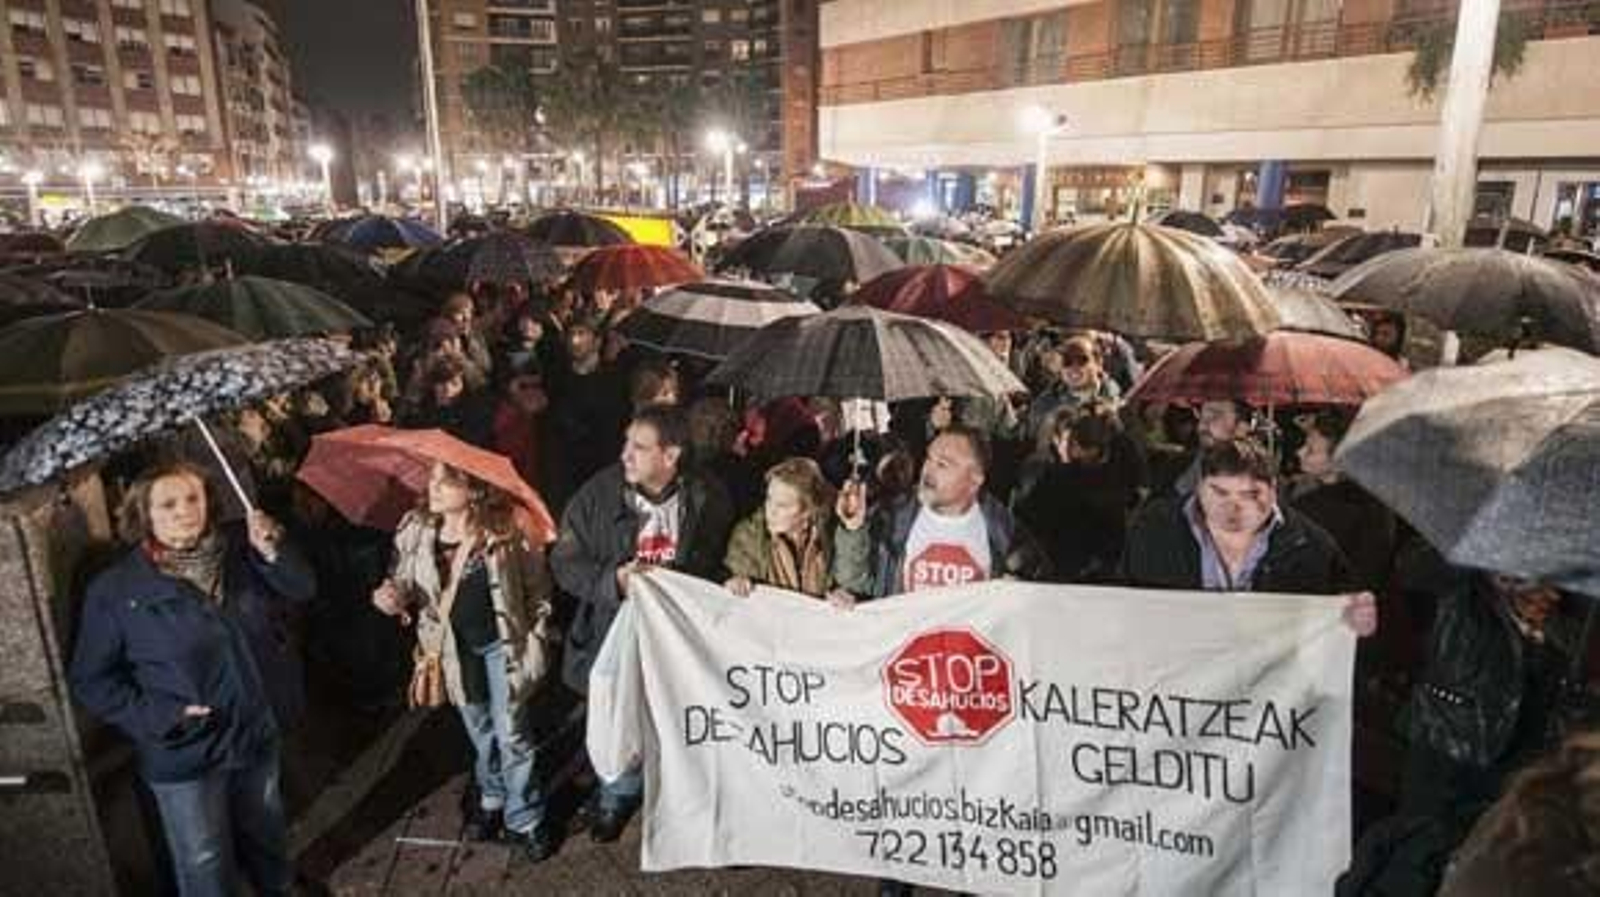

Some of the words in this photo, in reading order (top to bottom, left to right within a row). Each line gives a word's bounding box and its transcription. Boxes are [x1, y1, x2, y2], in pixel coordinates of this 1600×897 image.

[914, 560, 975, 587] STOP
[727, 665, 825, 709] STOP
[894, 652, 999, 694] STOP
[891, 684, 1007, 712] DESAHUCIOS
[1018, 678, 1317, 751] KALERATZEAK
[685, 705, 906, 765] DEAHUCIOS
[1071, 743, 1255, 803] GELDITU
[855, 829, 928, 866] 722
[936, 831, 988, 871] 134
[997, 838, 1057, 879] 858
